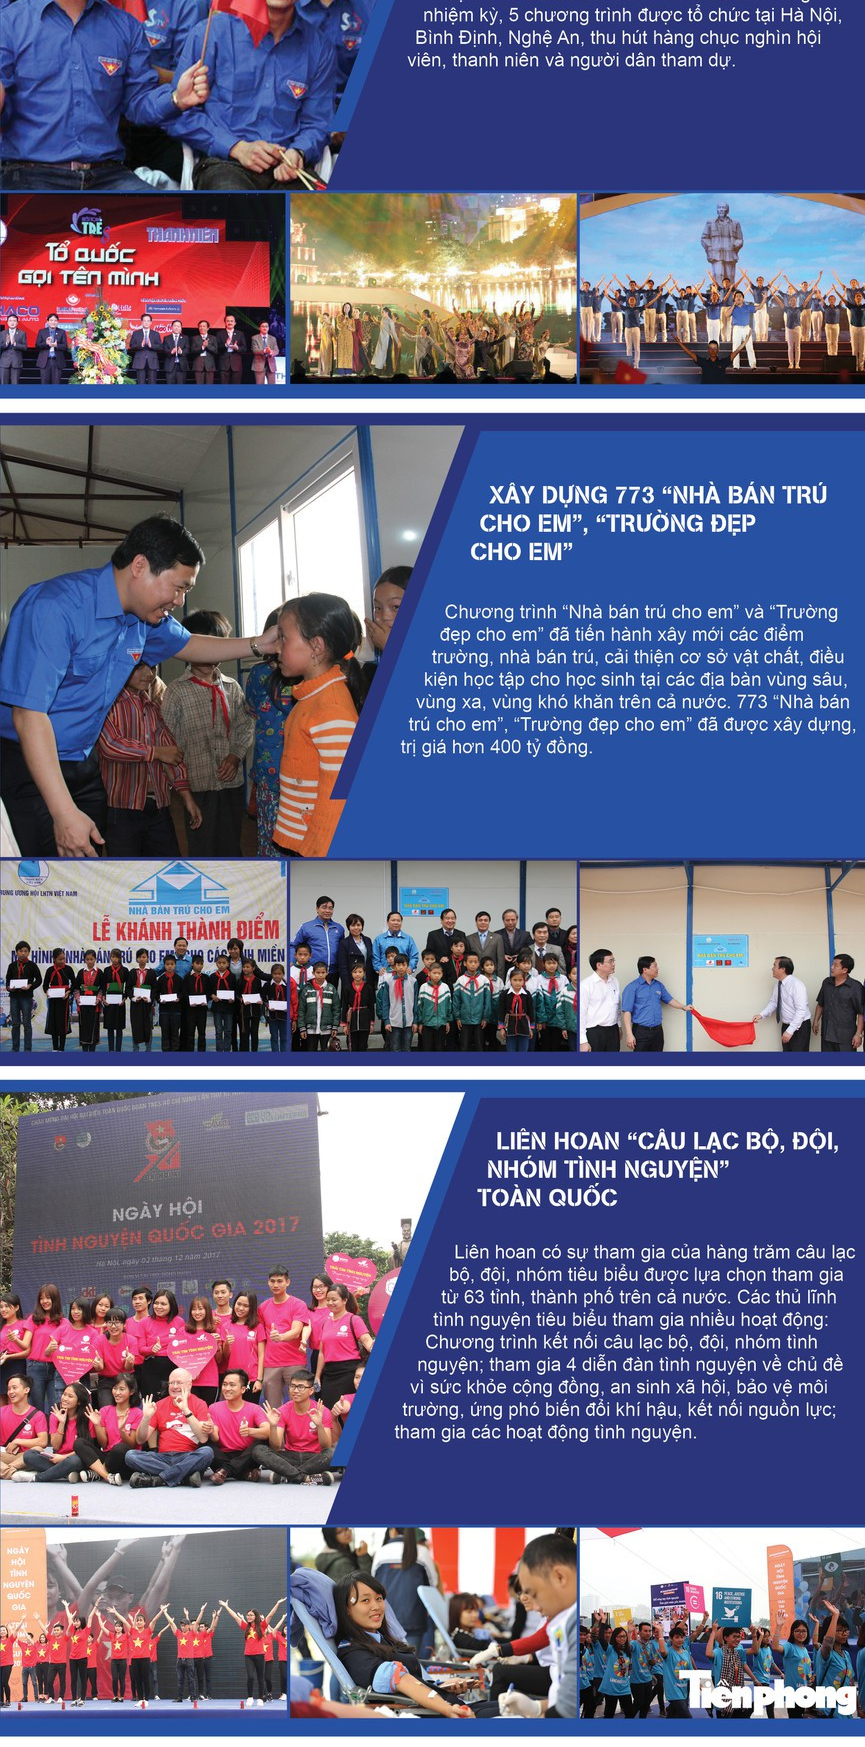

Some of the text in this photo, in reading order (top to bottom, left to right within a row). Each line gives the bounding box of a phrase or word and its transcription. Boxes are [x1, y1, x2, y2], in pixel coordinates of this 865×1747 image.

[45, 240, 136, 263] TỔ QUỐC
[18, 266, 159, 288] GỌI TÊN MÌNH
[129, 905, 230, 915] NHÀ BÁN TRÚ CHO EM
[93, 912, 279, 941] LỄ KHÁNH THÀNH ĐIỂM
[113, 1196, 203, 1222] NGÀY HỘI
[31, 1216, 300, 1254] TÌNH NGUYỆN QUỐC GIA 2017
[715, 1591, 722, 1600] 16
